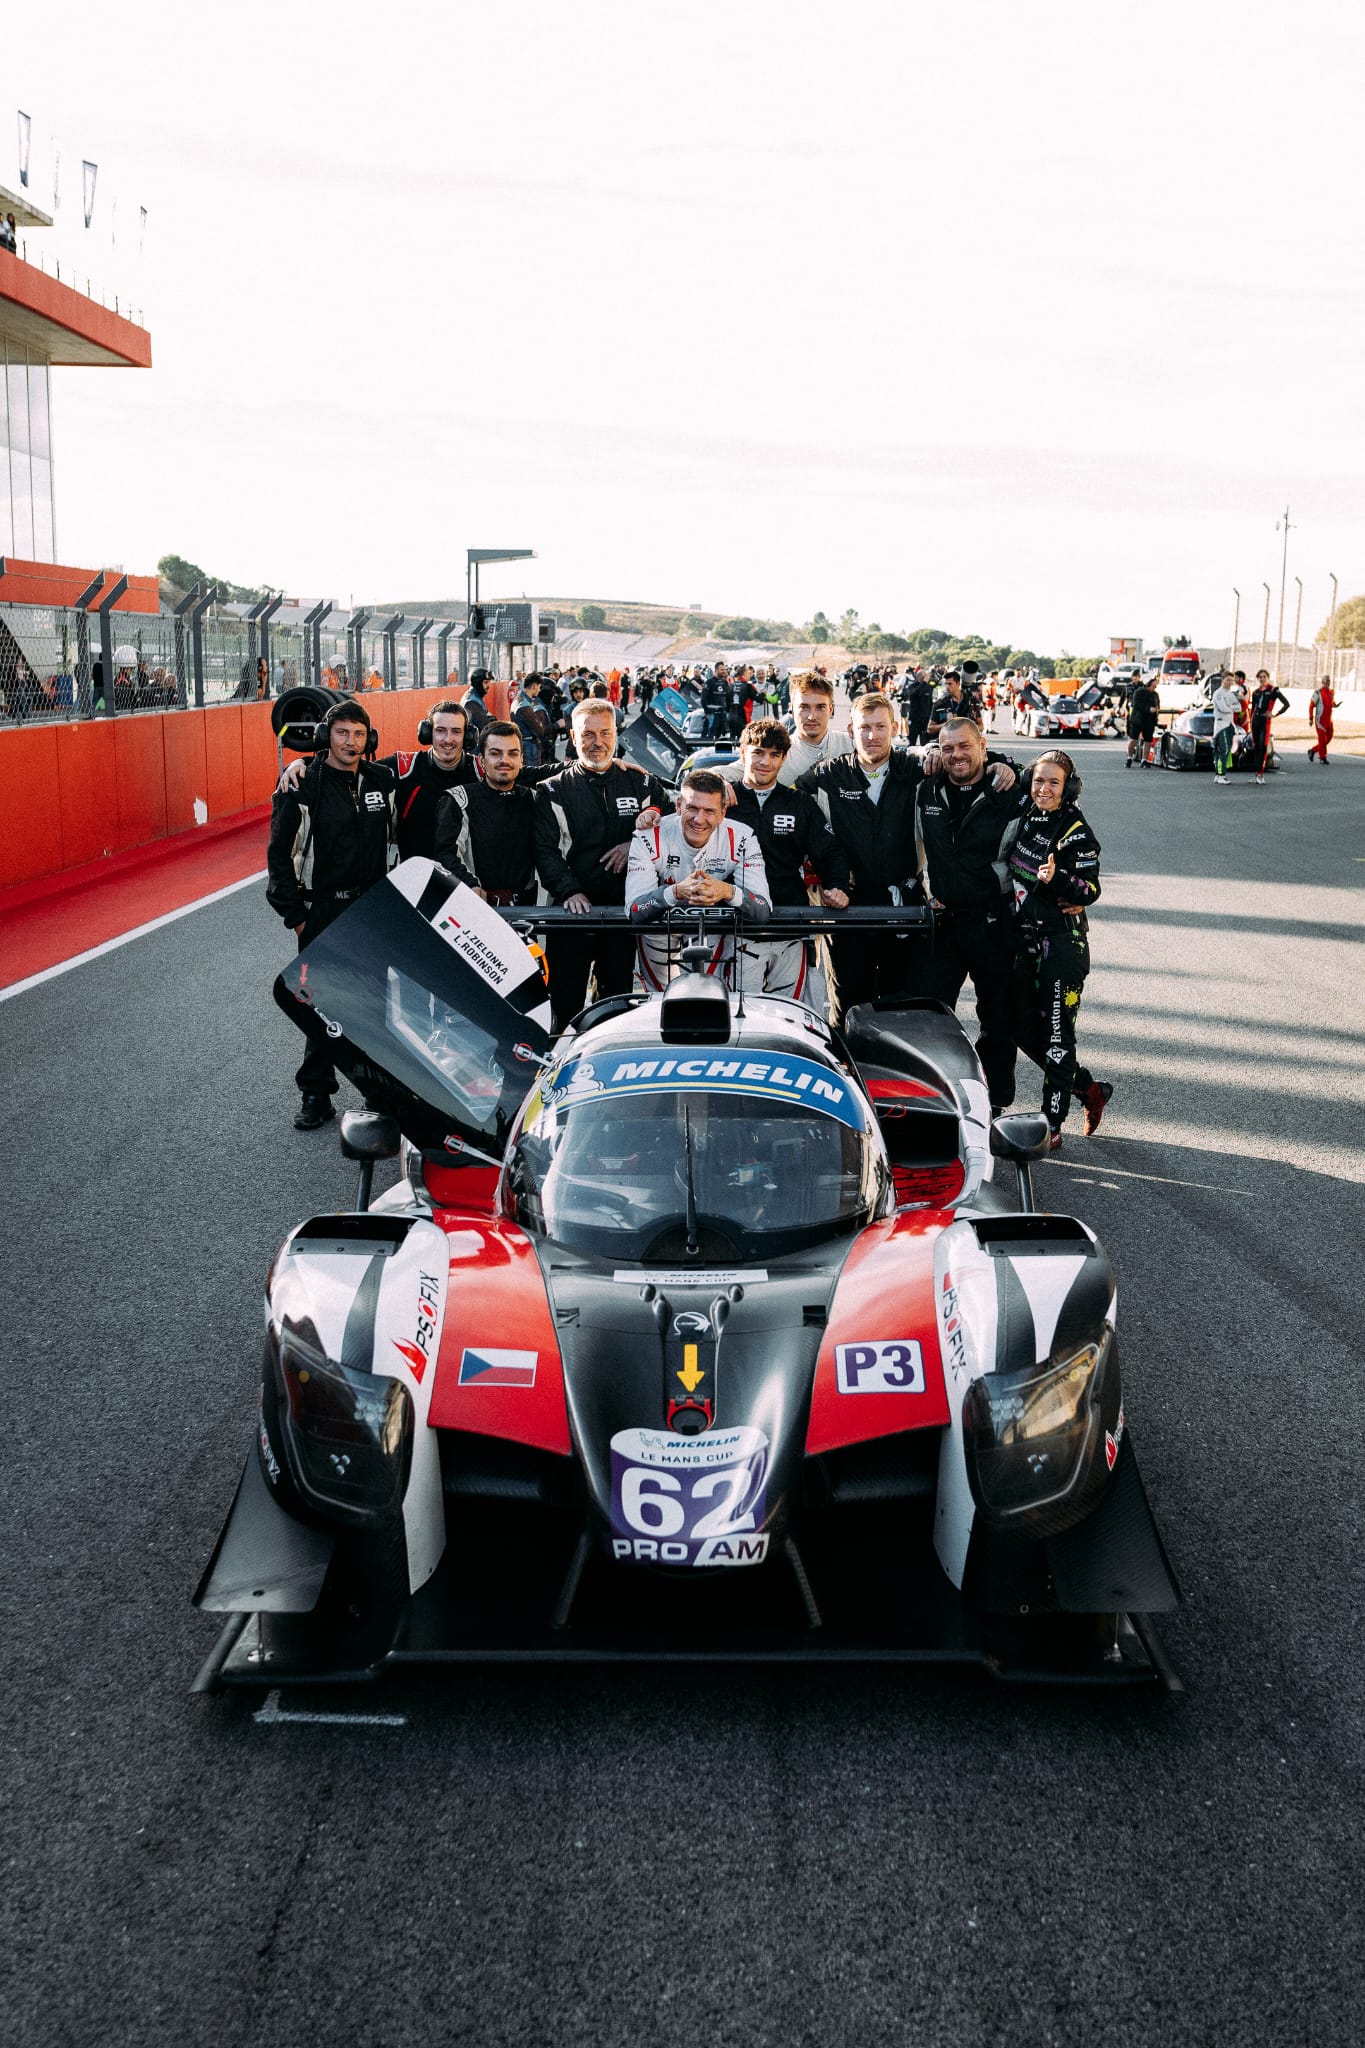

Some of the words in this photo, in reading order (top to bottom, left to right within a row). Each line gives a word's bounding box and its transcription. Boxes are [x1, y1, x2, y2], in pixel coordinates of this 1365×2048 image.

[453, 935, 503, 985] L.ROBINSON
[462, 929, 509, 975] J.ZIELONKA
[1050, 1000, 1061, 1043] Bretton
[611, 1060, 844, 1104] MICHELIN
[415, 1270, 439, 1356] PSOFIX
[843, 1344, 916, 1388] P3
[641, 1451, 656, 1462] LE
[661, 1453, 701, 1463] MANS
[706, 1451, 734, 1462] CUP
[666, 1435, 741, 1449] MICHELIN
[621, 1466, 756, 1540] 62
[612, 1538, 689, 1561] PRO
[708, 1540, 765, 1560] AM
